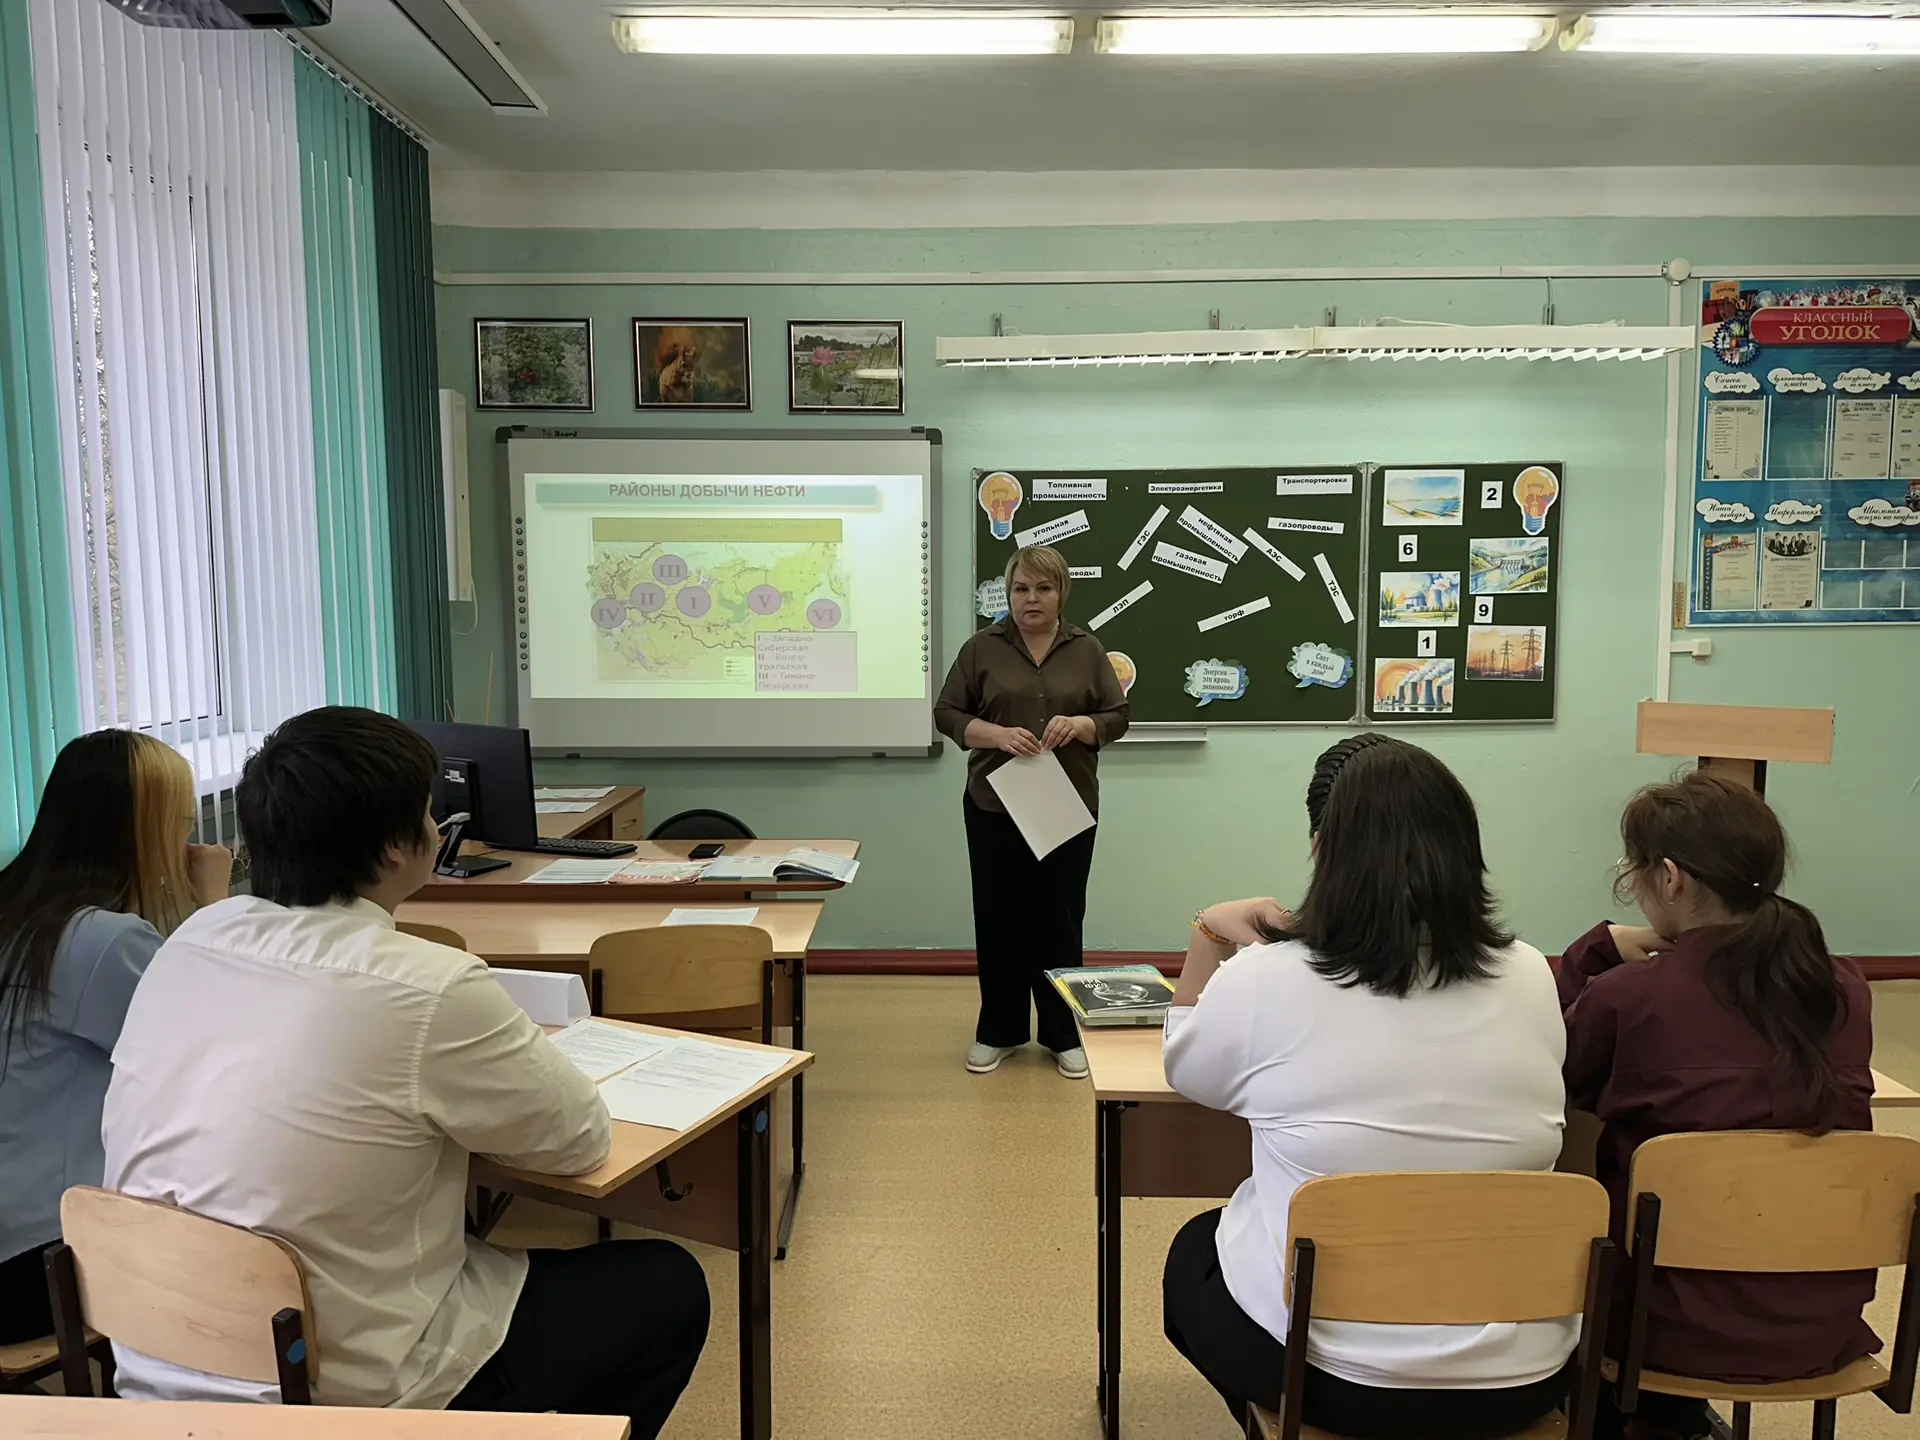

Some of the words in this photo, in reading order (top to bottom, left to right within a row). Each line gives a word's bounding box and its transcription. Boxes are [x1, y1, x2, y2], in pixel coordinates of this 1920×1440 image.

[1794, 310, 1873, 323] КЛАССНЫЙ
[1779, 325, 1881, 340] УГОЛОК
[609, 481, 675, 497] РАЙОНЫ
[680, 484, 748, 499] ДОБЫЧИ
[753, 485, 806, 497] НЕФТИ
[1486, 487, 1498, 501] 2
[1708, 503, 1732, 511] Наши
[1719, 508, 1746, 519] победы
[1770, 507, 1819, 518] Информация
[1863, 506, 1901, 514] Школьная
[1033, 519, 1069, 538] угольная
[1198, 517, 1233, 544] нефтяная
[1278, 521, 1334, 531] газопроводы
[1137, 530, 1151, 546] ГЭС
[1179, 517, 1239, 562] промышленность
[1266, 548, 1282, 562] АЭС
[1403, 542, 1414, 556] 6
[1175, 551, 1207, 565] газовая
[659, 564, 682, 578] III
[1153, 555, 1222, 581] промышленность
[1328, 580, 1340, 597] ТЭС
[640, 592, 655, 606] II
[757, 595, 772, 609] V
[1112, 598, 1130, 613] ЛЭП
[599, 608, 620, 622] IV
[813, 608, 836, 622] VI
[1224, 609, 1245, 621] торф
[1478, 604, 1489, 617] 9
[758, 644, 809, 652] Сибирская
[1422, 636, 1431, 650] 1
[1315, 653, 1330, 662] Свет
[758, 663, 808, 671] Уральская
[1203, 668, 1228, 677] Энергия
[1311, 660, 1335, 671] каждый
[758, 682, 809, 690] Печорская
